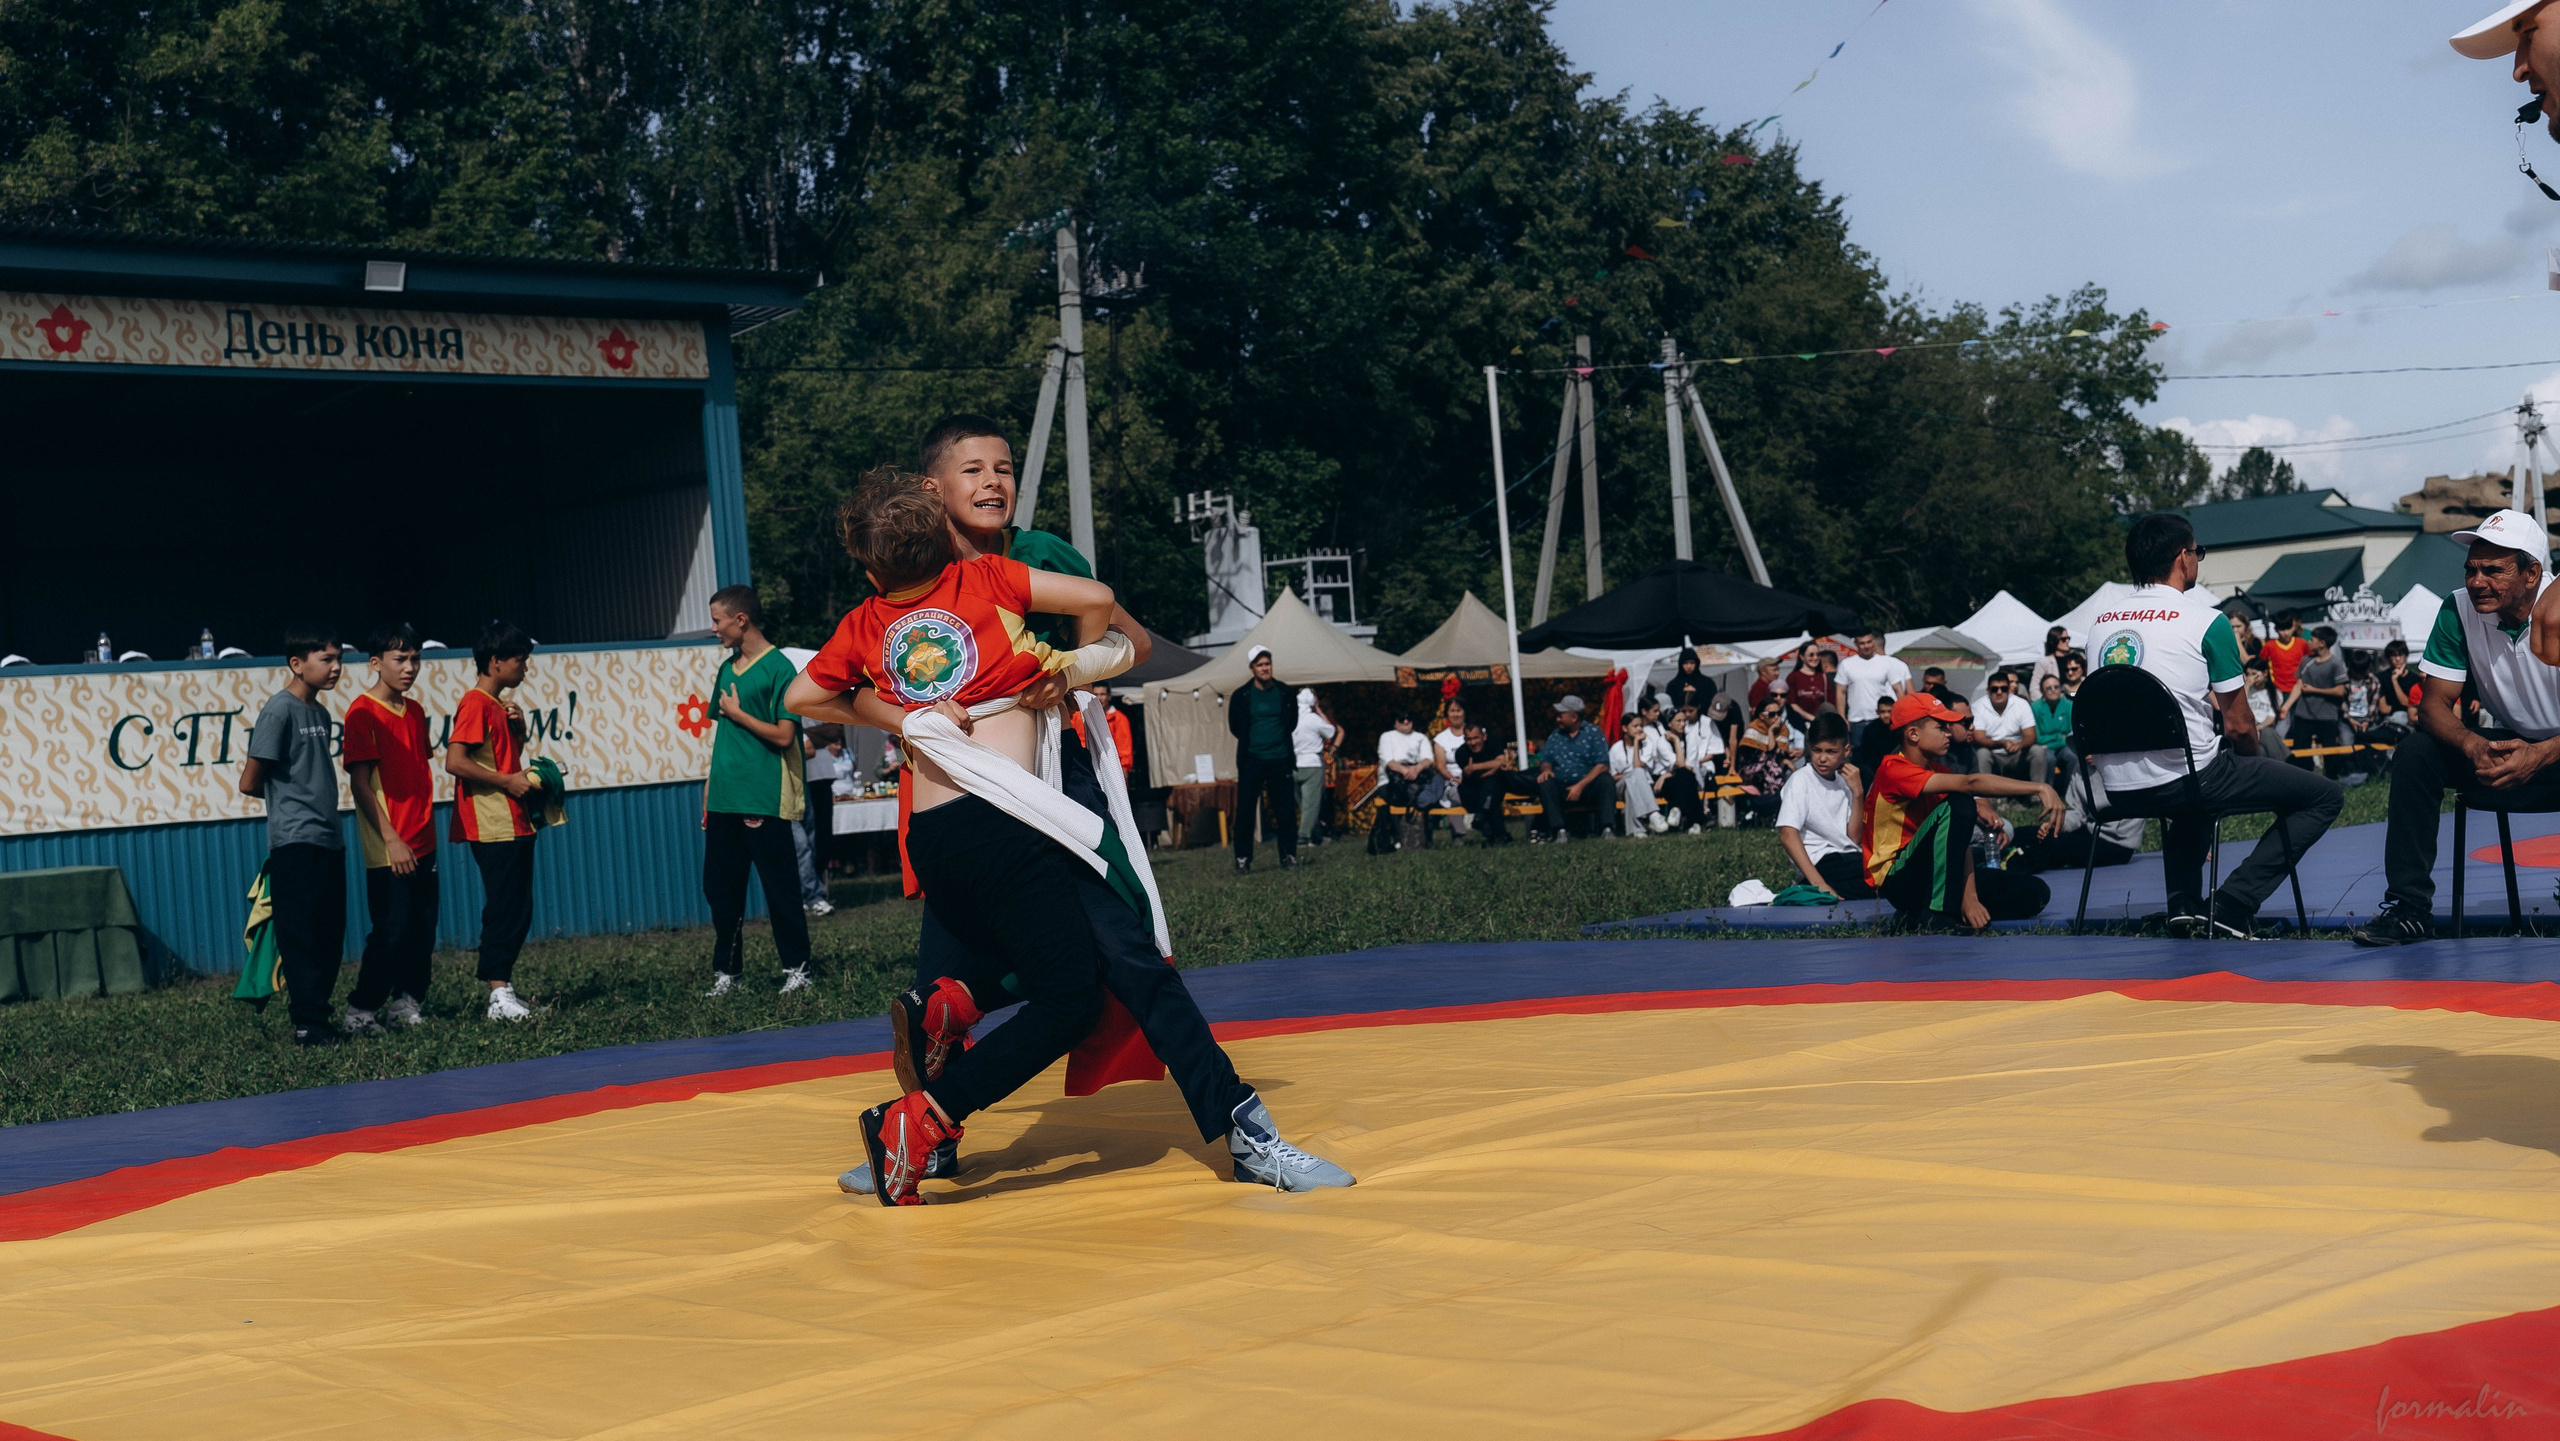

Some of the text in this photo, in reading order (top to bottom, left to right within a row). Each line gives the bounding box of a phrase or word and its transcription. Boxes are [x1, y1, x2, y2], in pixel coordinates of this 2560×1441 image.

[224, 309, 464, 360] День коня
[894, 612, 962, 630] ФЕДЕРАЦИЯСЕ
[108, 715, 154, 771] С
